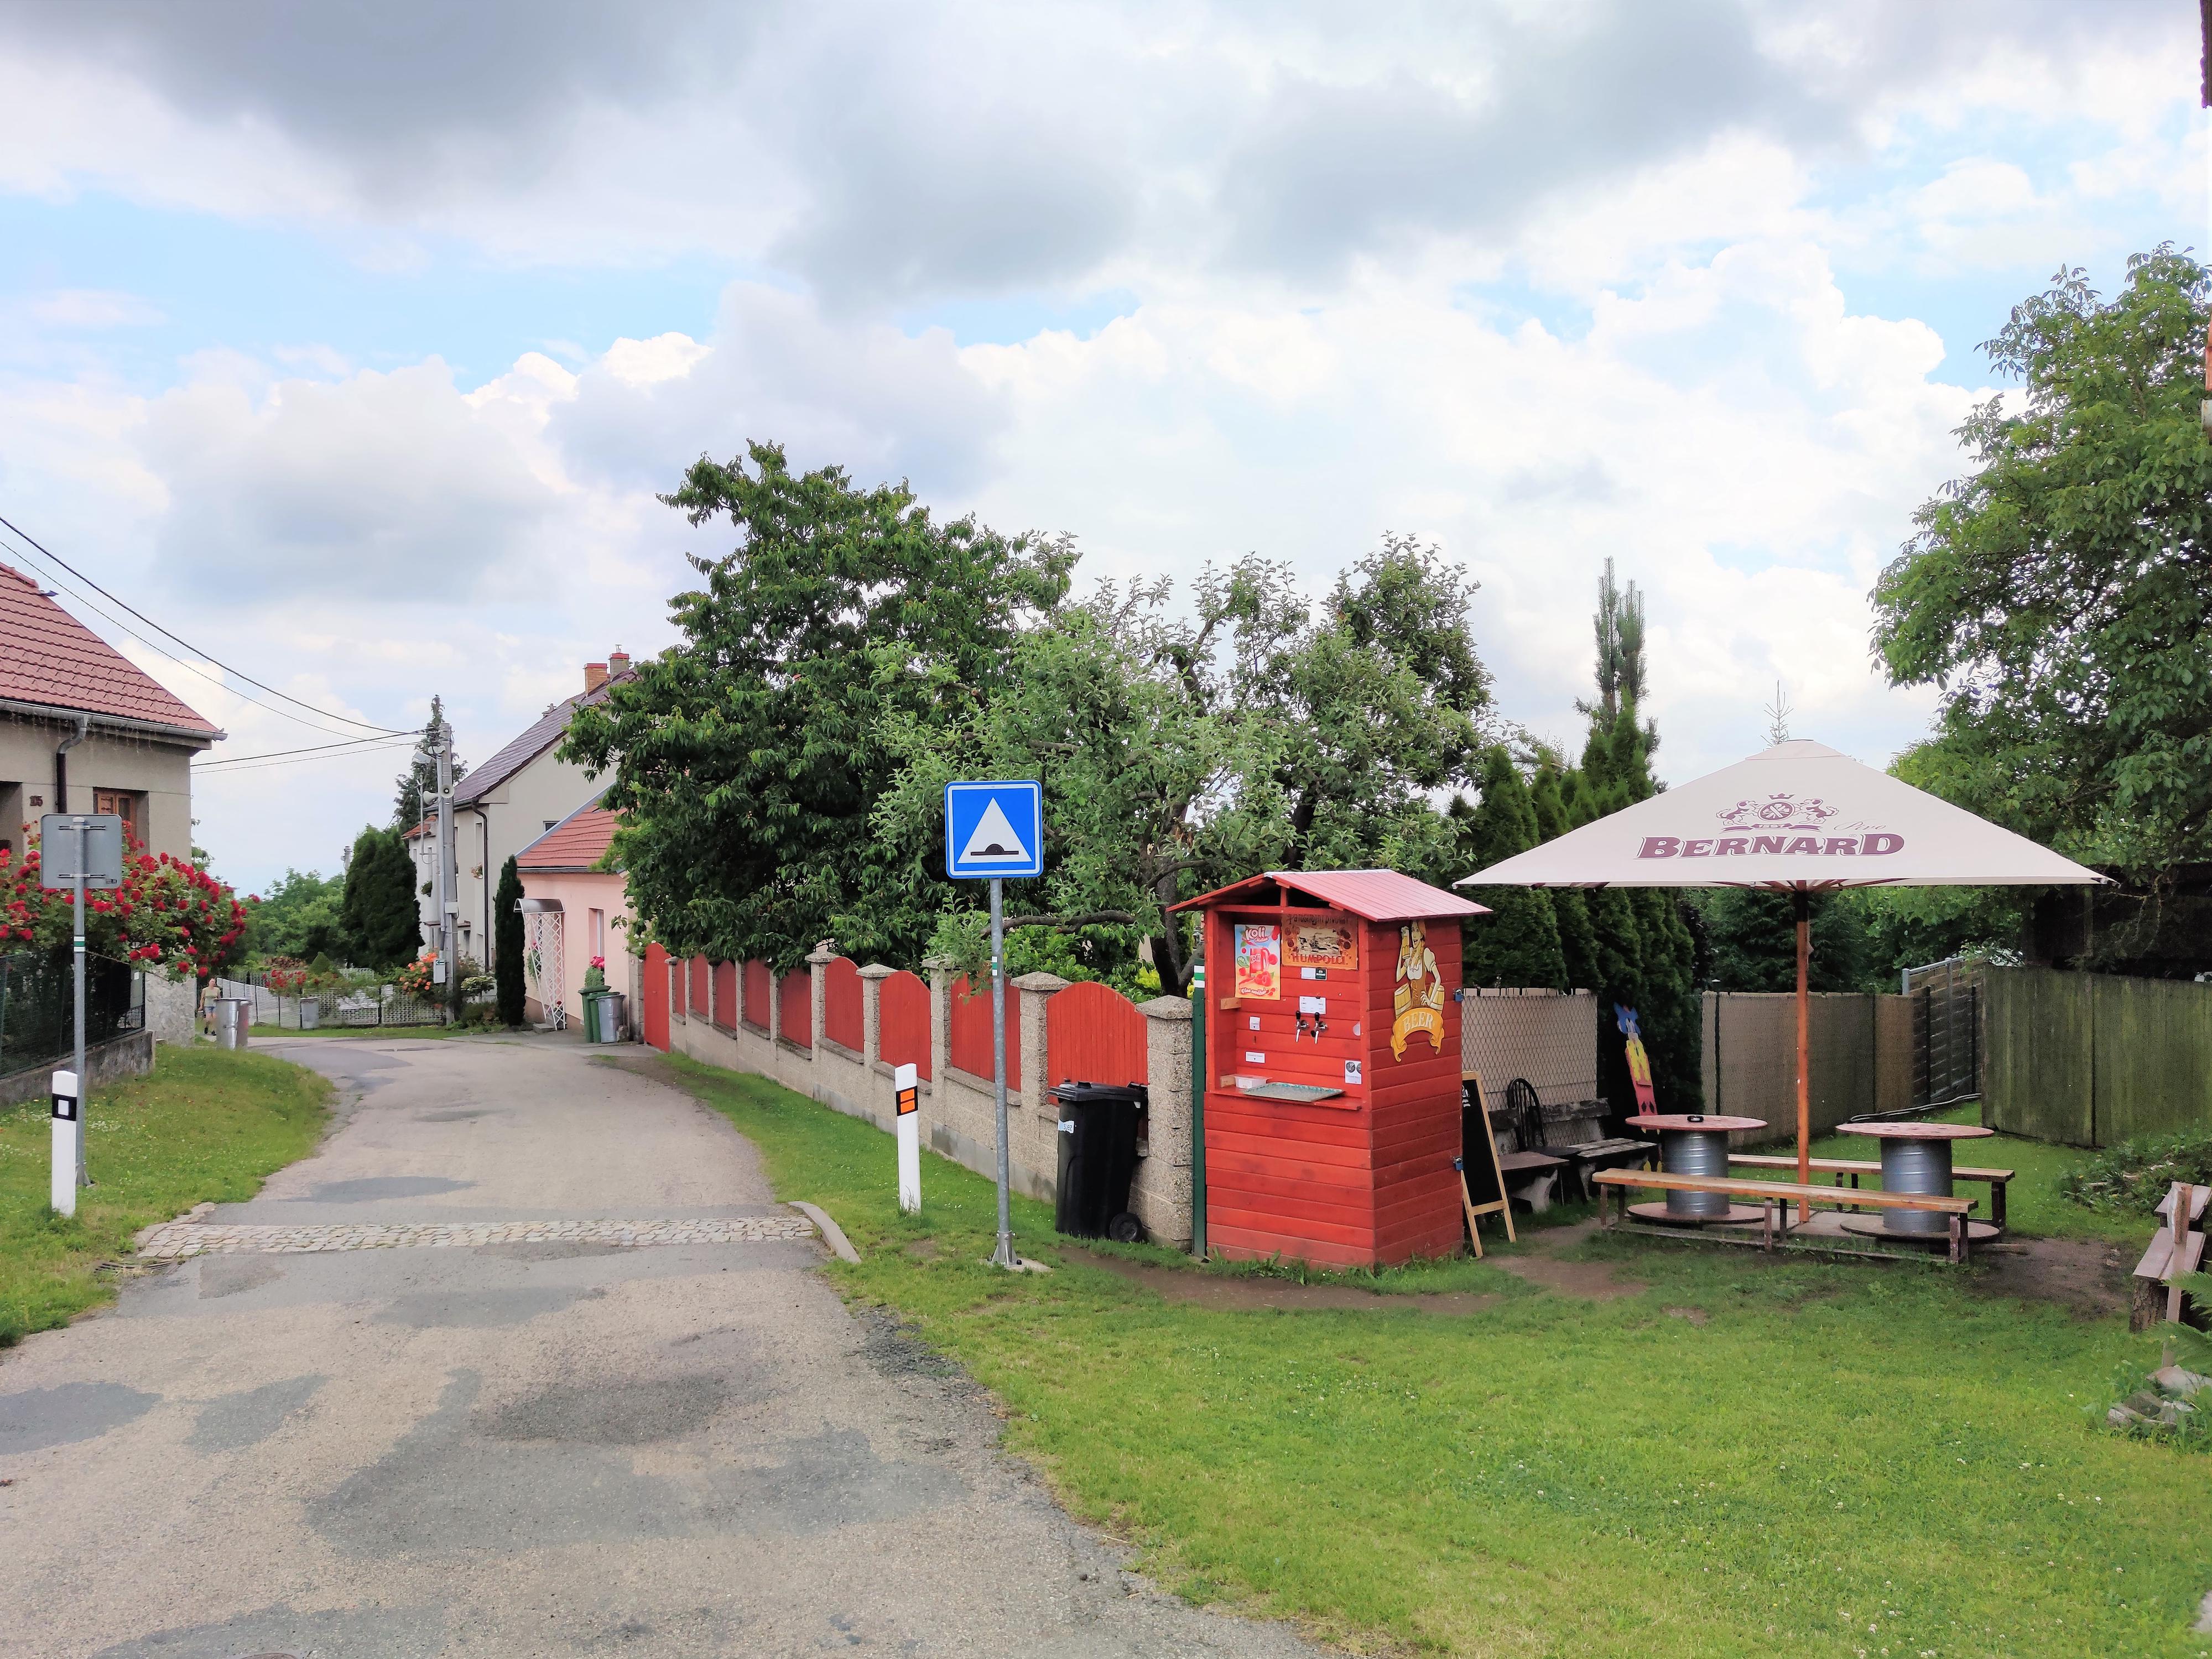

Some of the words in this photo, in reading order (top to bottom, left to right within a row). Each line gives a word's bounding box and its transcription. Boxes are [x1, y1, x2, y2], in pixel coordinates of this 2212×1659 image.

[1834, 819, 1887, 831] Pivo
[1635, 833, 1905, 859] BERNARD
[1402, 1011, 1434, 1034] BEER
